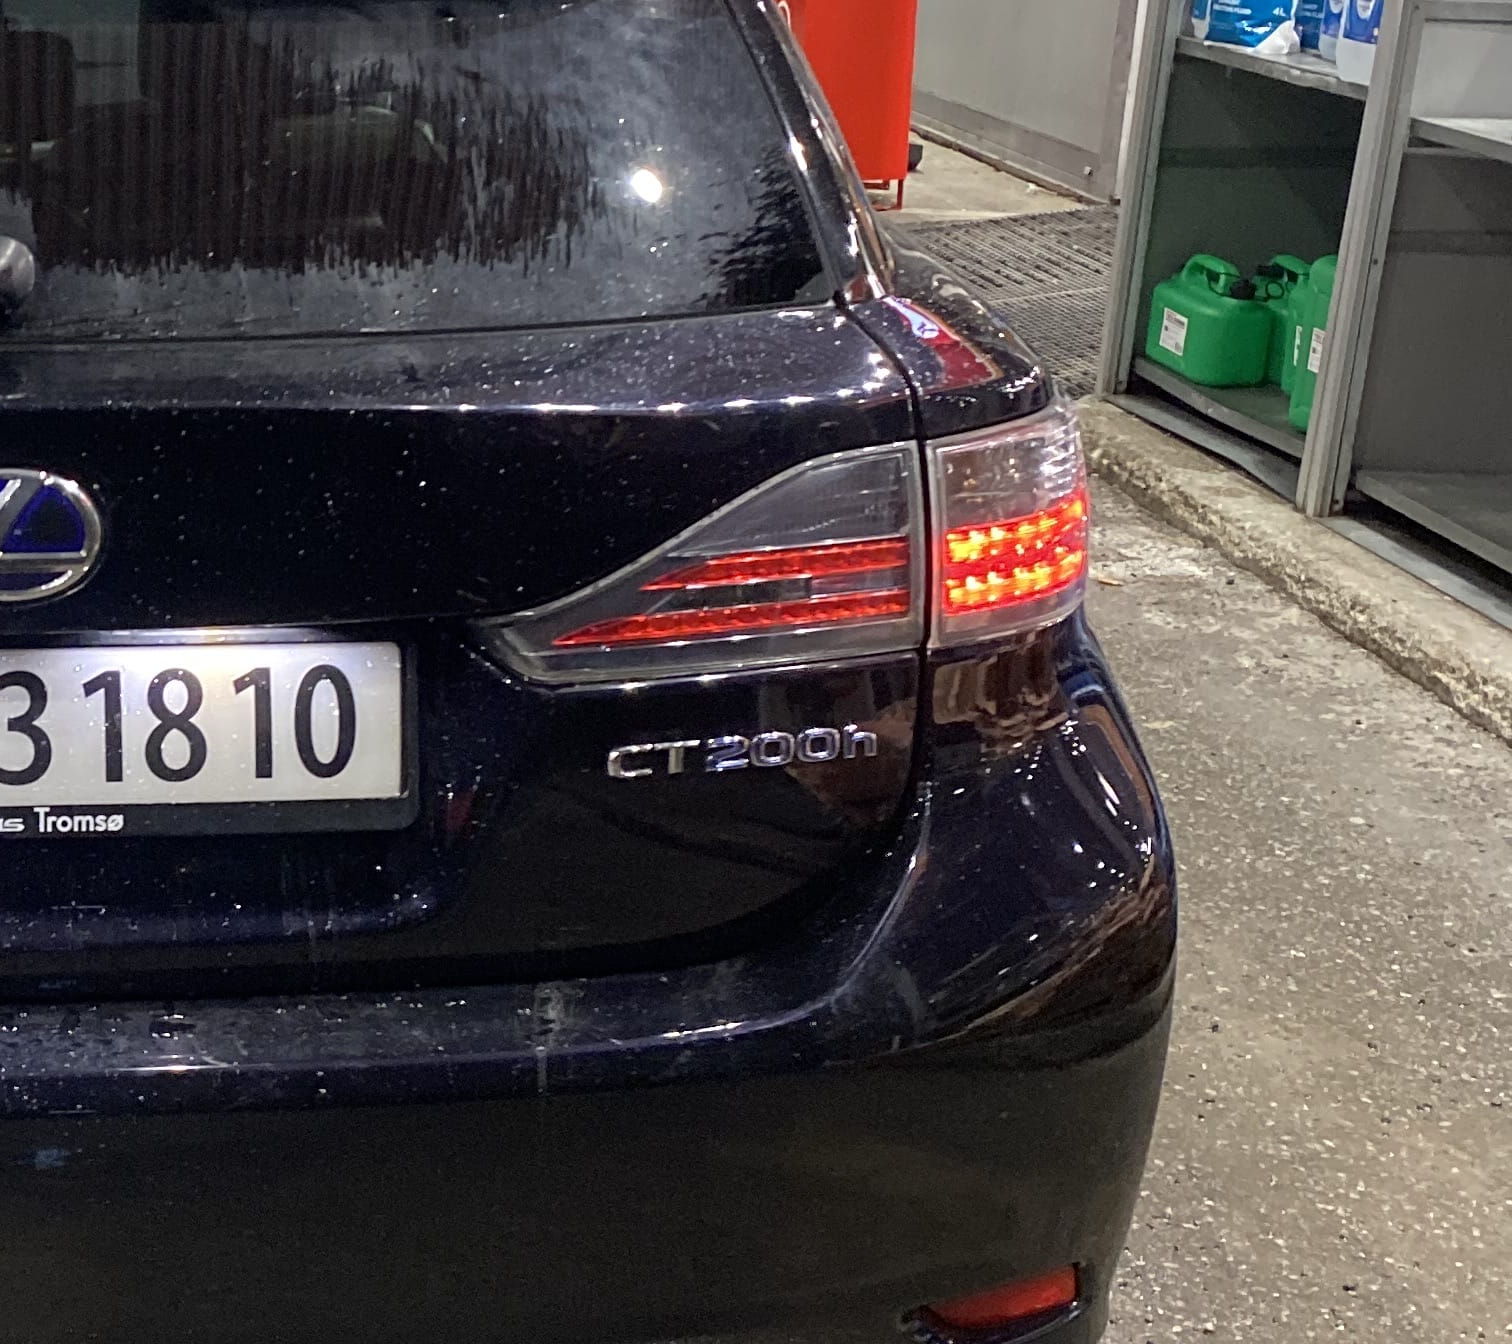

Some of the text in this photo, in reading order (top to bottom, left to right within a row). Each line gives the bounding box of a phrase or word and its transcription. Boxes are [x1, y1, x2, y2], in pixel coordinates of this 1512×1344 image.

[1272, 7, 1287, 17] 4L
[607, 722, 878, 779] CT 200h
[33, 806, 125, 834] Tromsø
